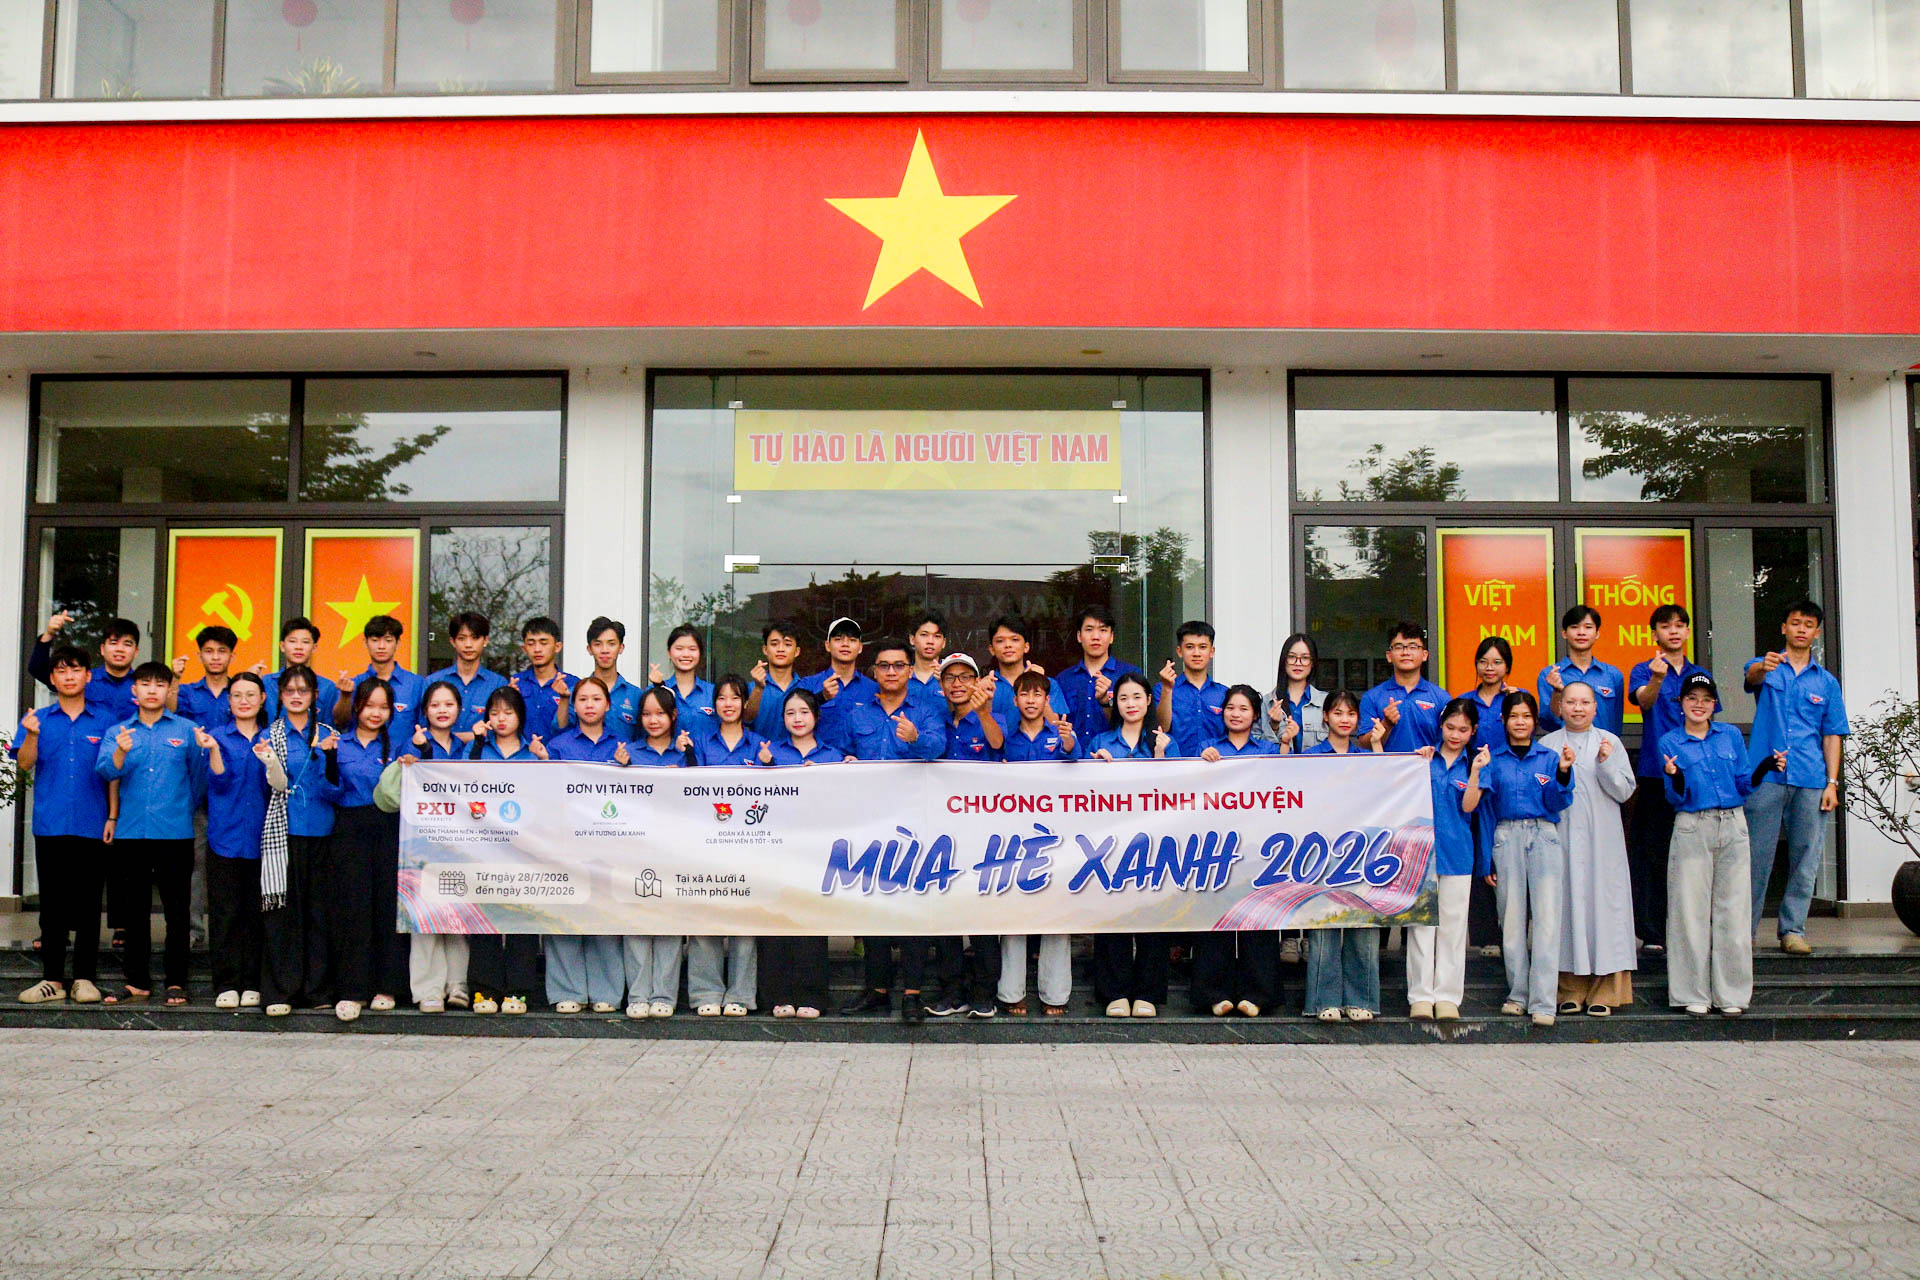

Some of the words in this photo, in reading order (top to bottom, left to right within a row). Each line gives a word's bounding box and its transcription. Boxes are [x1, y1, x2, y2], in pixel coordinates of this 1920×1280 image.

[749, 431, 784, 466] TỰ
[792, 429, 845, 463] HÀO
[855, 429, 886, 463] LÀ
[895, 429, 976, 463] NGƯỜI
[984, 430, 1042, 466] VIỆT
[1051, 432, 1109, 463] NAM
[1464, 579, 1515, 611] VIỆT
[1589, 574, 1675, 607] THỐNG
[1480, 624, 1536, 646] NAM
[1618, 624, 1658, 646] NH
[422, 782, 447, 793] ĐƠN
[450, 784, 460, 796] VỊ
[464, 780, 479, 793] TỔ
[481, 781, 516, 794] CHỨC
[566, 782, 593, 794] ĐƠN
[595, 784, 607, 796] VỊ
[609, 782, 627, 794] TÀI
[629, 783, 654, 797] TRỢ
[683, 785, 710, 796] ĐƠN
[712, 786, 724, 799] VỊ
[727, 783, 762, 797] ĐỒNG
[764, 784, 799, 796] HÀNH
[946, 792, 1053, 814] CHƯƠNG
[1058, 788, 1131, 813] TRÌNH
[1138, 788, 1196, 812] TÌNH
[1203, 786, 1304, 814] NGUYỆN
[416, 802, 456, 816] PXU
[821, 825, 963, 895] MÙA
[973, 823, 1063, 895] HÈ
[1068, 828, 1243, 895] XANH
[1253, 828, 1403, 890] 2026
[475, 872, 489, 881] Từ
[490, 872, 515, 883] ngày
[517, 872, 569, 883] 28/7/2026
[675, 873, 690, 884] Tại
[692, 874, 704, 883] xã
[706, 874, 713, 883] A
[715, 873, 737, 883] Lưới
[739, 874, 746, 883] 4
[475, 885, 494, 895] đến
[496, 885, 521, 896] ngày
[523, 886, 575, 896] 30/7/2026
[675, 887, 707, 897] Thành
[709, 886, 729, 898] phố
[730, 886, 751, 896] Huế
